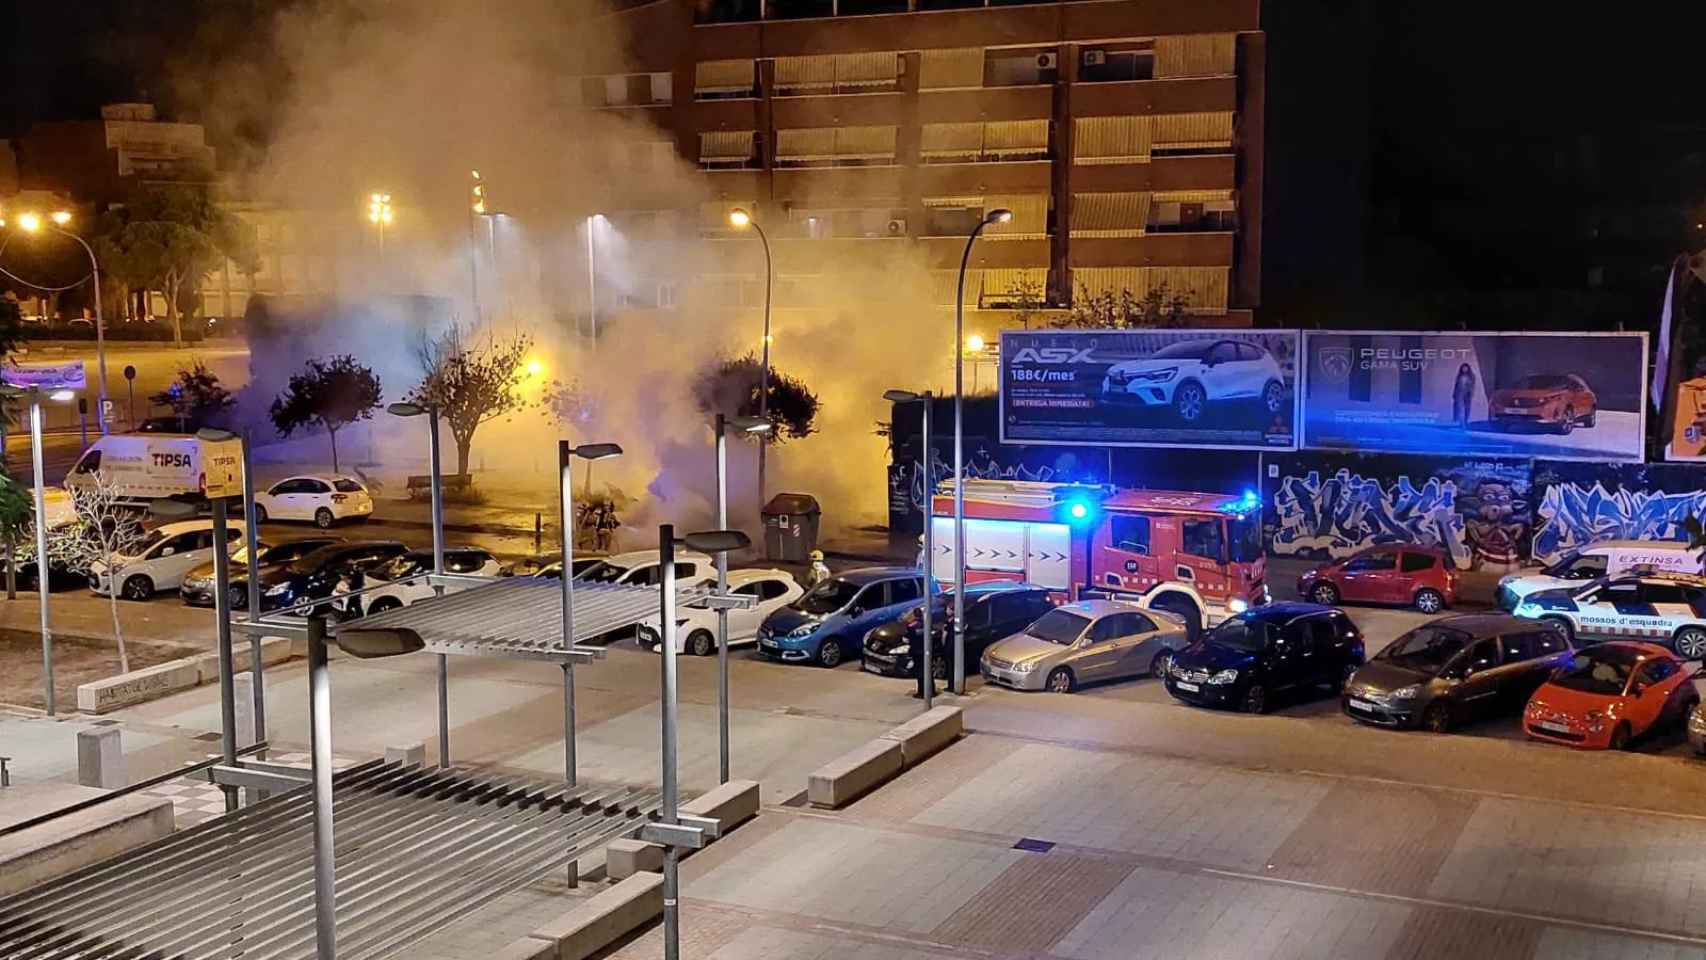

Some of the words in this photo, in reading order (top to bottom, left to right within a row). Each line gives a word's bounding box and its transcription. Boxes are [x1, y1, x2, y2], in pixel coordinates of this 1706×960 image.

[1011, 347, 1097, 363] ASX
[1360, 348, 1472, 359] PEUGEOT
[1360, 360, 1398, 370] GAMA
[1401, 361, 1429, 371] SUV
[1011, 369, 1075, 382] 188€/mes
[103, 400, 113, 415] P
[152, 453, 192, 468] TIPSA
[213, 457, 236, 466] TIPSA
[1619, 555, 1684, 565] EXTINSA
[1580, 615, 1616, 625] mossos
[1619, 616, 1673, 627] d'esquadra
